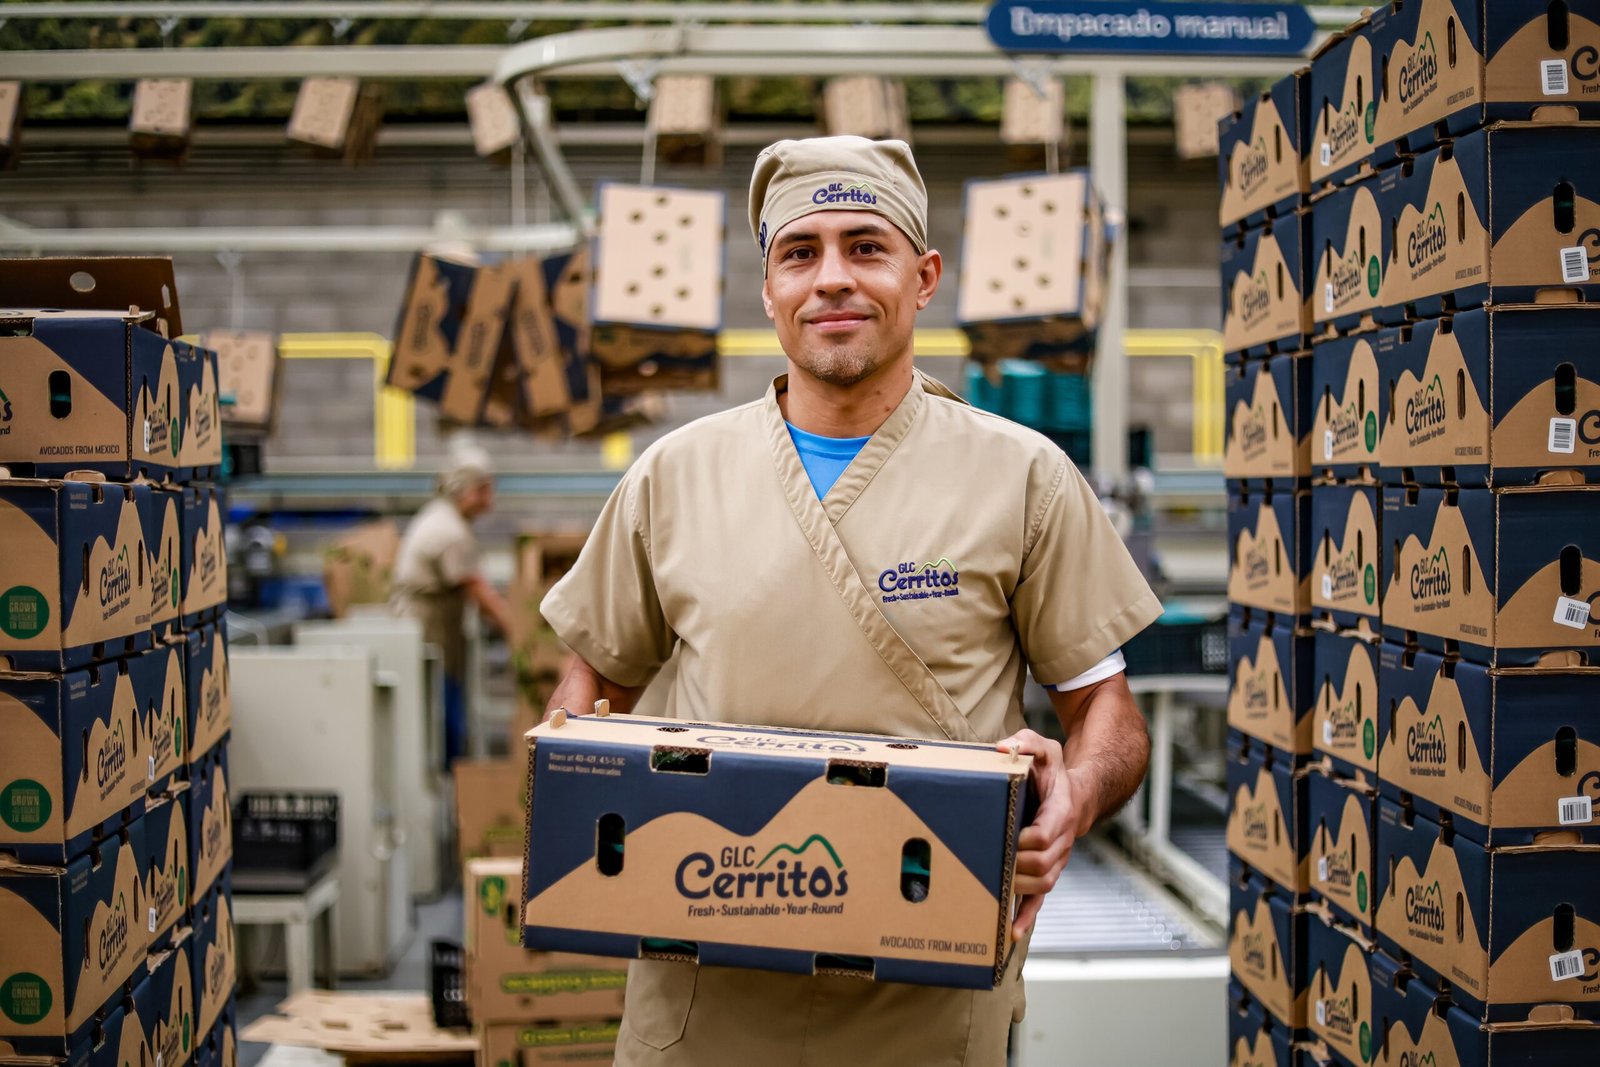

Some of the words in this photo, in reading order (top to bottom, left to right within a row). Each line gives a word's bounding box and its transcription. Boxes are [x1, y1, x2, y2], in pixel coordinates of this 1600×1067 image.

[1010, 6, 1171, 42] Empacado
[1175, 12, 1289, 40] manual
[1399, 55, 1438, 103] Cerritos
[812, 188, 877, 205] Cerritos
[828, 183, 843, 192] GLC
[1408, 225, 1446, 268] Cerritos
[1406, 396, 1446, 435] Cerritos
[39, 446, 73, 455] AVOCADOS
[75, 445, 93, 455] FROM
[95, 445, 120, 454] MEXICO
[878, 569, 959, 592] Cerritos
[898, 562, 915, 574] GLC
[1411, 564, 1451, 600] Cerritos
[9, 602, 37, 612] GROWN
[1407, 726, 1447, 765] Cerritos
[721, 845, 755, 868] GLC
[675, 852, 848, 899] Cerritos
[1405, 887, 1445, 931] Cerritos
[880, 936, 925, 950] AVOCADOS
[928, 939, 952, 953] FROM
[954, 942, 987, 956] MEXICO
